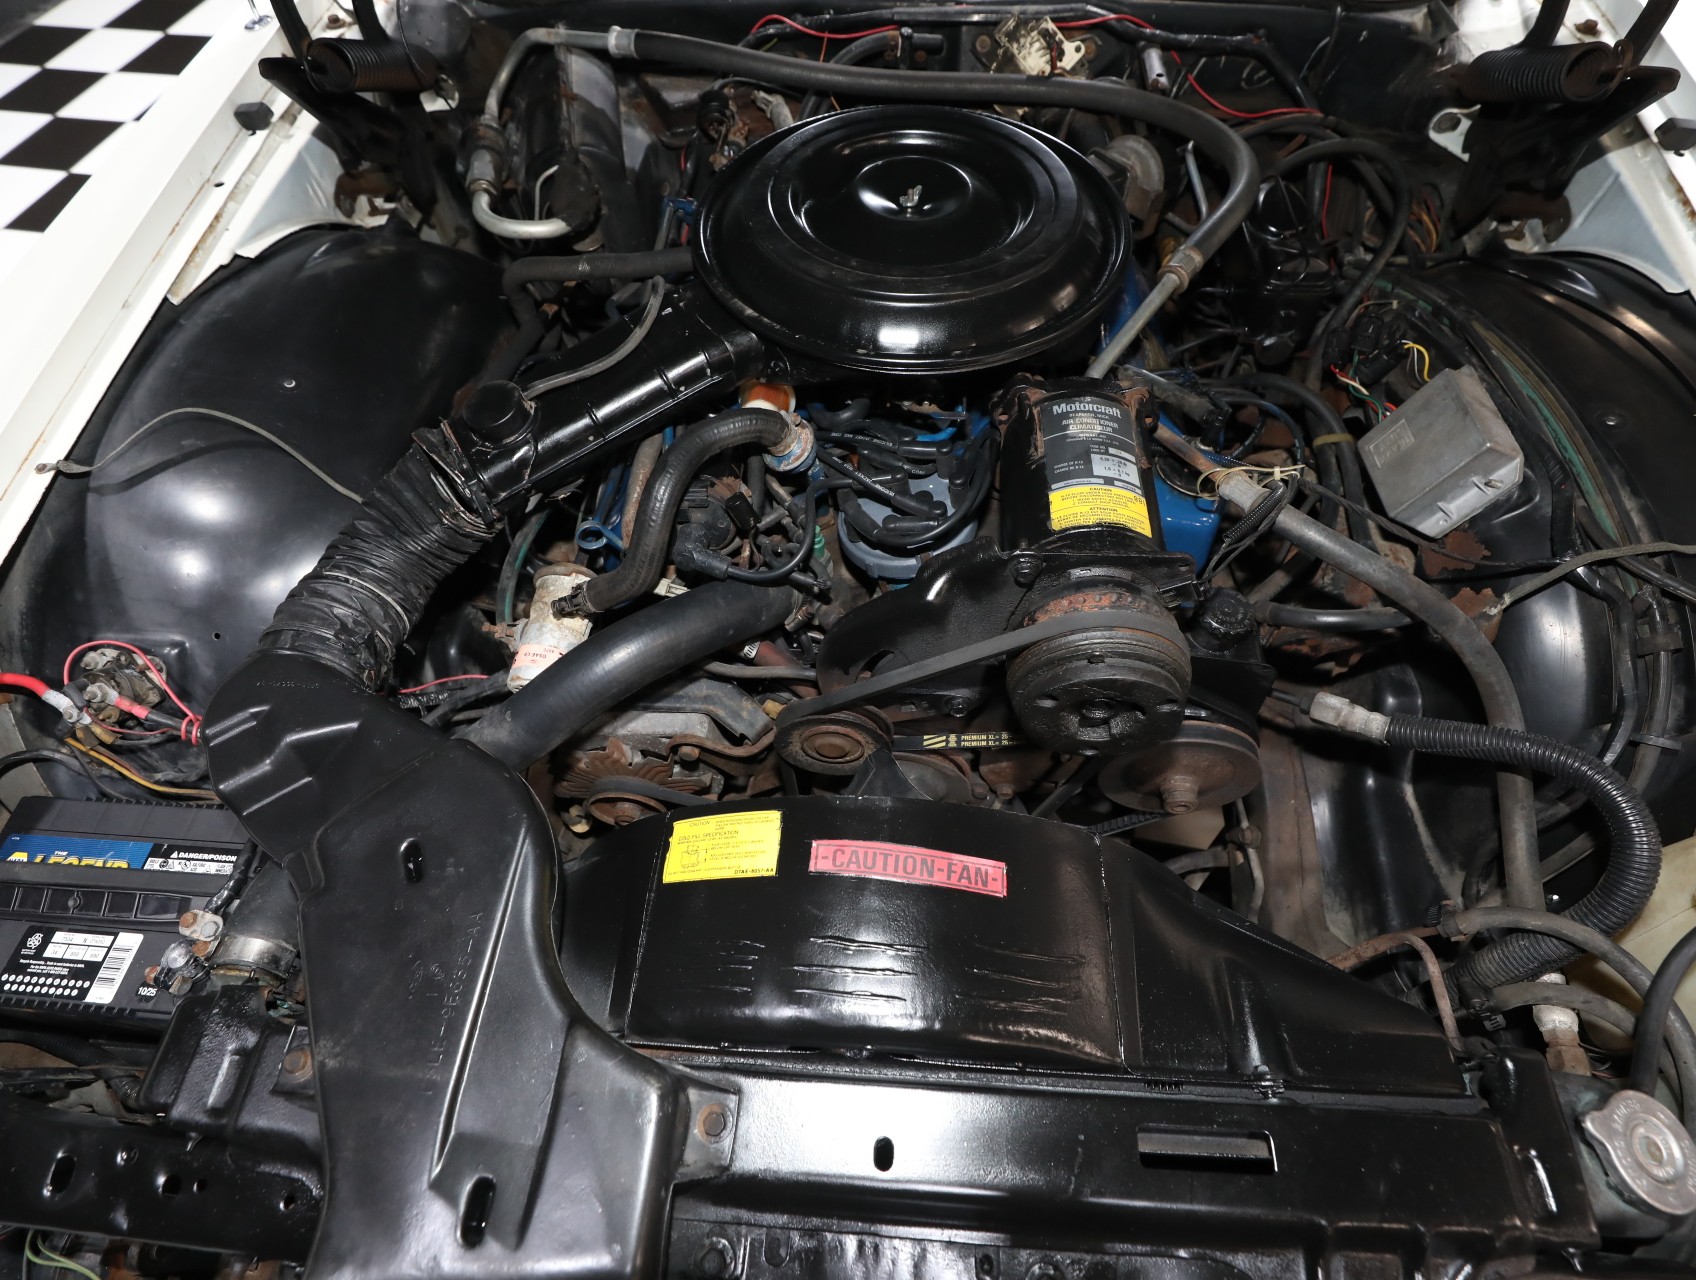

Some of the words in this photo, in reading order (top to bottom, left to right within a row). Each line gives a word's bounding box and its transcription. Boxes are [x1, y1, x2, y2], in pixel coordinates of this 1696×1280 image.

[1052, 401, 1122, 419] Motorcraft
[1069, 424, 1113, 433] CLIMATISEUR
[1076, 418, 1119, 429] CONDITIONER
[689, 820, 711, 828] CAUTION
[703, 830, 739, 839] SPECIFICATION
[178, 851, 238, 862] DANGER/POISON
[138, 986, 157, 996] 10/25
